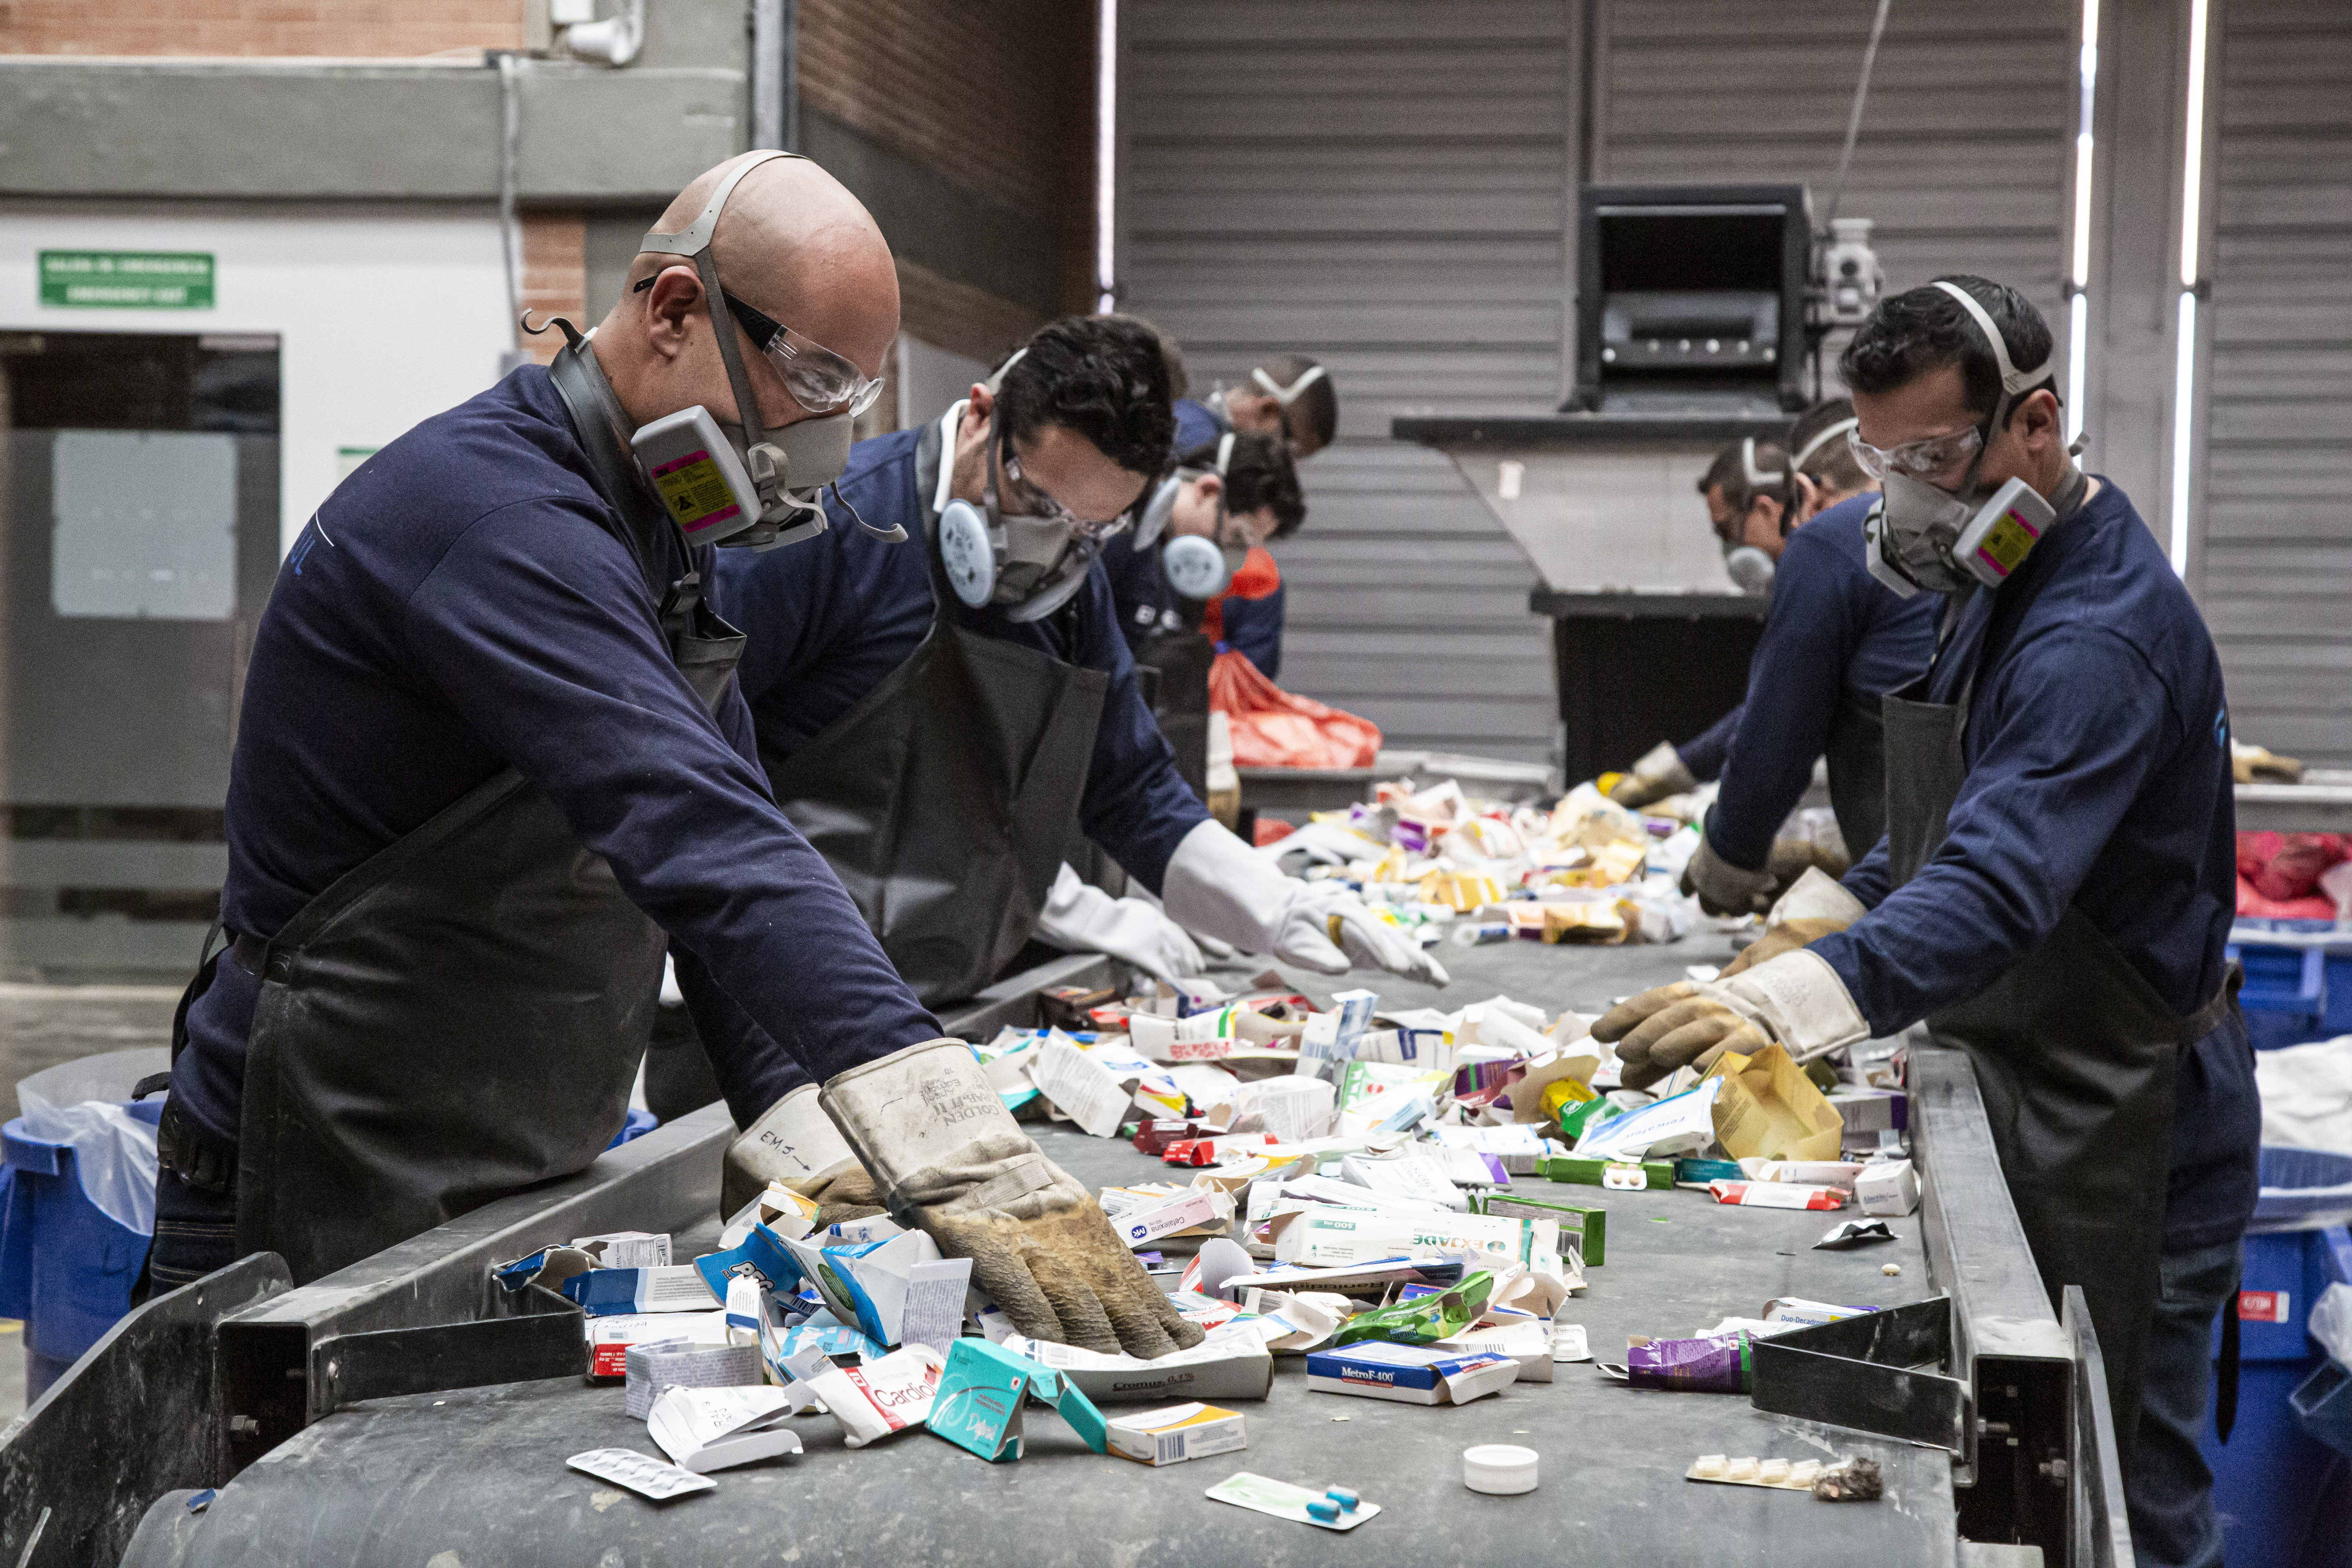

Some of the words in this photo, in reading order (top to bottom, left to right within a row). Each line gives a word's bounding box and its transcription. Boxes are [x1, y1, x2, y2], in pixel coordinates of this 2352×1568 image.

[943, 1104, 1000, 1127] GOLDEN
[1133, 1227, 1146, 1237] MK
[1151, 1216, 1185, 1232] Cefalexina
[1412, 1234, 1484, 1250] EXJADE
[1342, 1366, 1393, 1382] MetroF-400
[1113, 1381, 1164, 1389] Cromus
